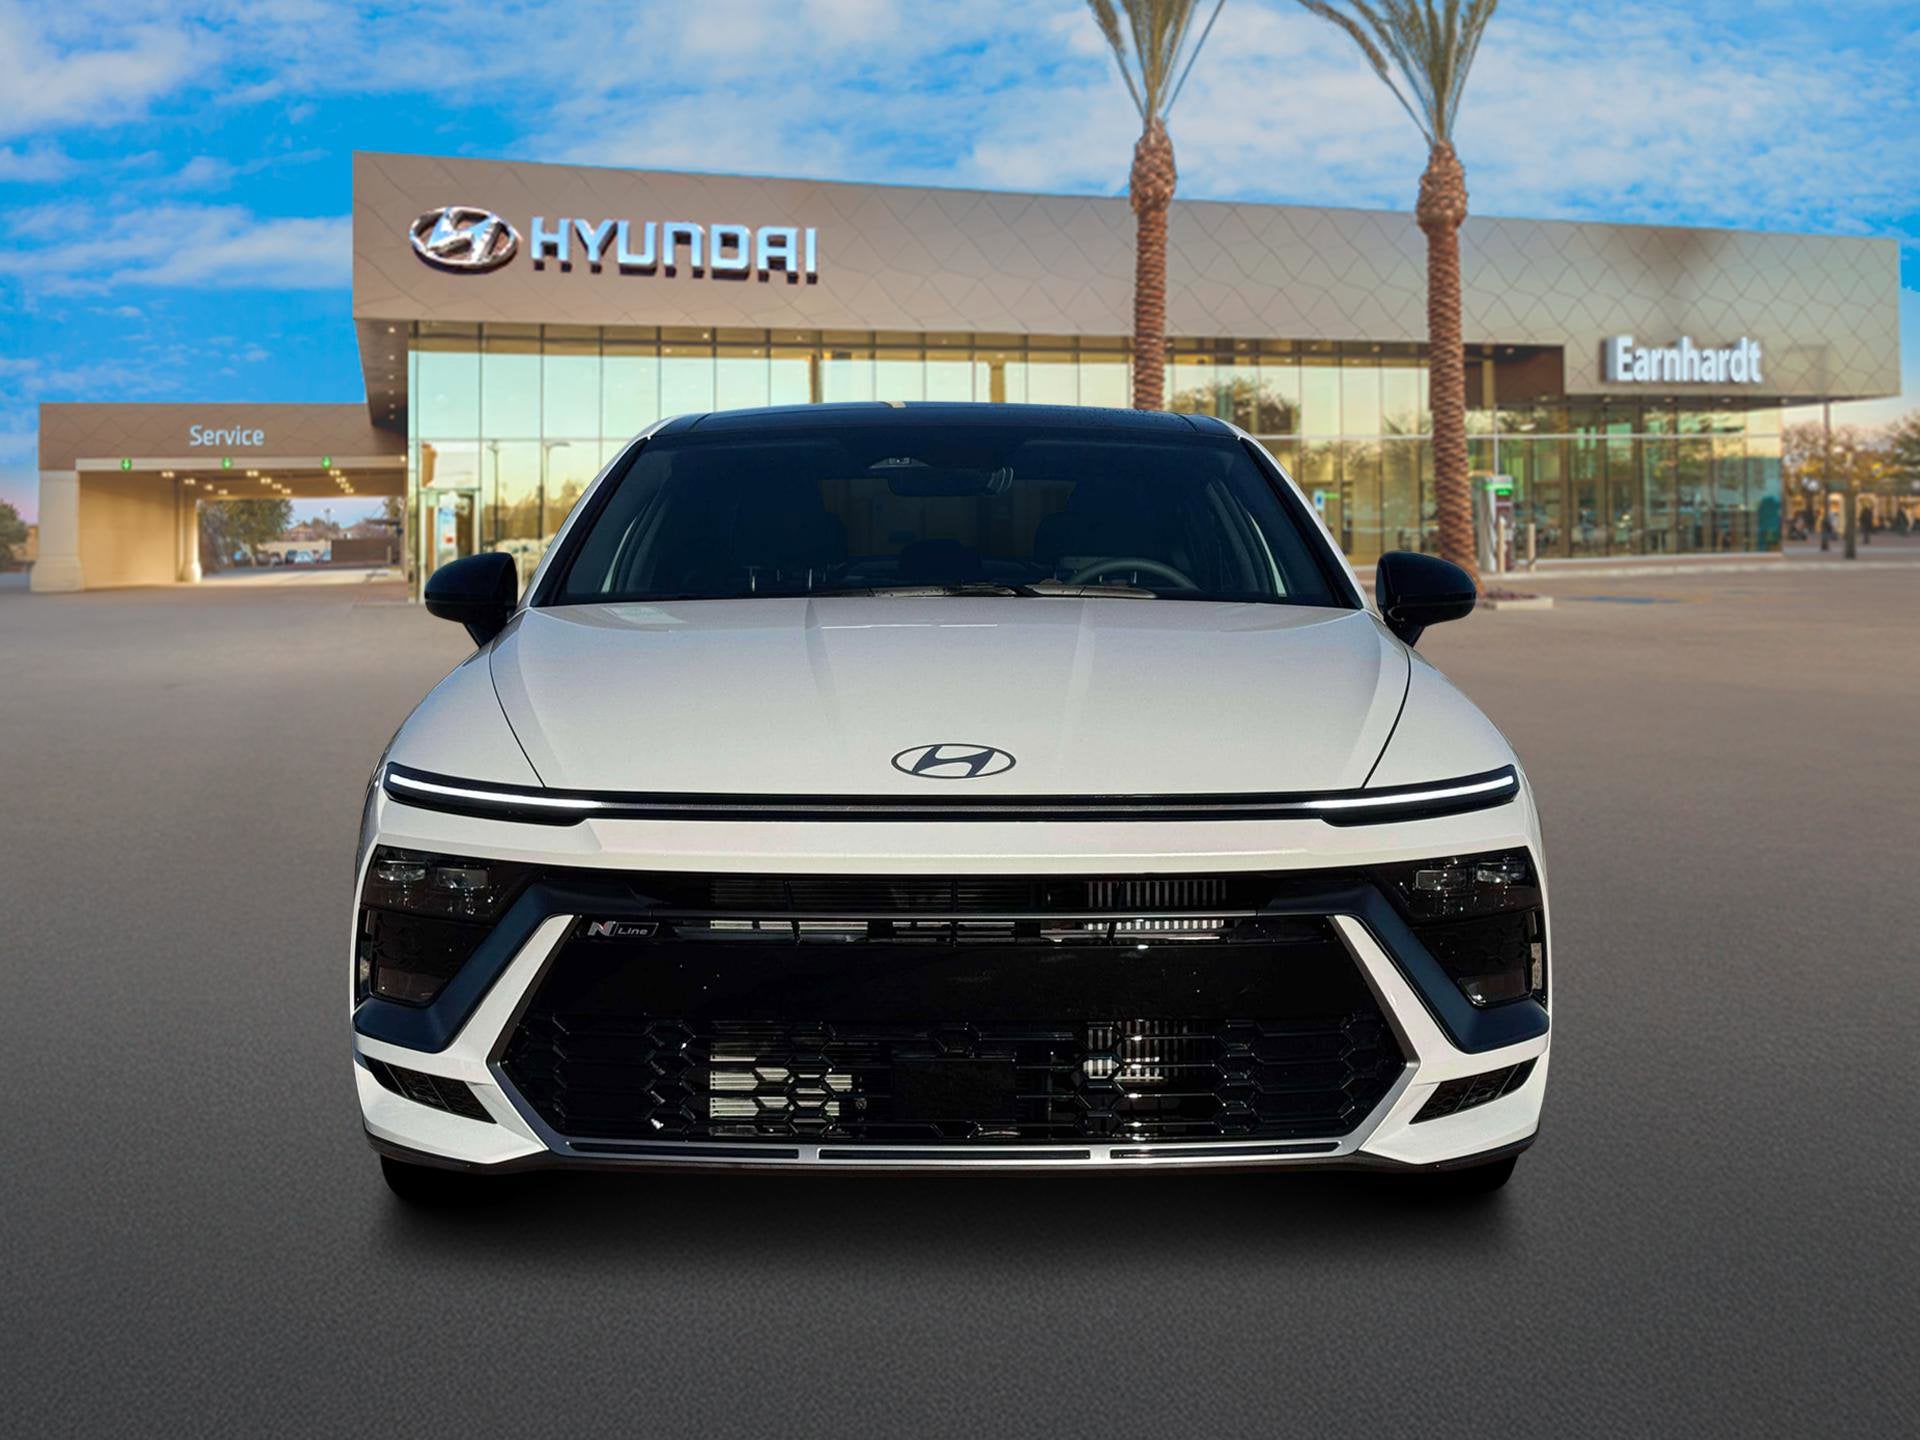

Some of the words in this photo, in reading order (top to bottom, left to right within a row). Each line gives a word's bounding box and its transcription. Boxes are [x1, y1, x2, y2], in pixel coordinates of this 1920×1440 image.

[530, 216, 818, 281] HYUNDAI
[1608, 334, 1764, 383] Earnhardt
[189, 423, 265, 447] Service
[587, 920, 614, 937] N
[617, 927, 649, 936] Line
